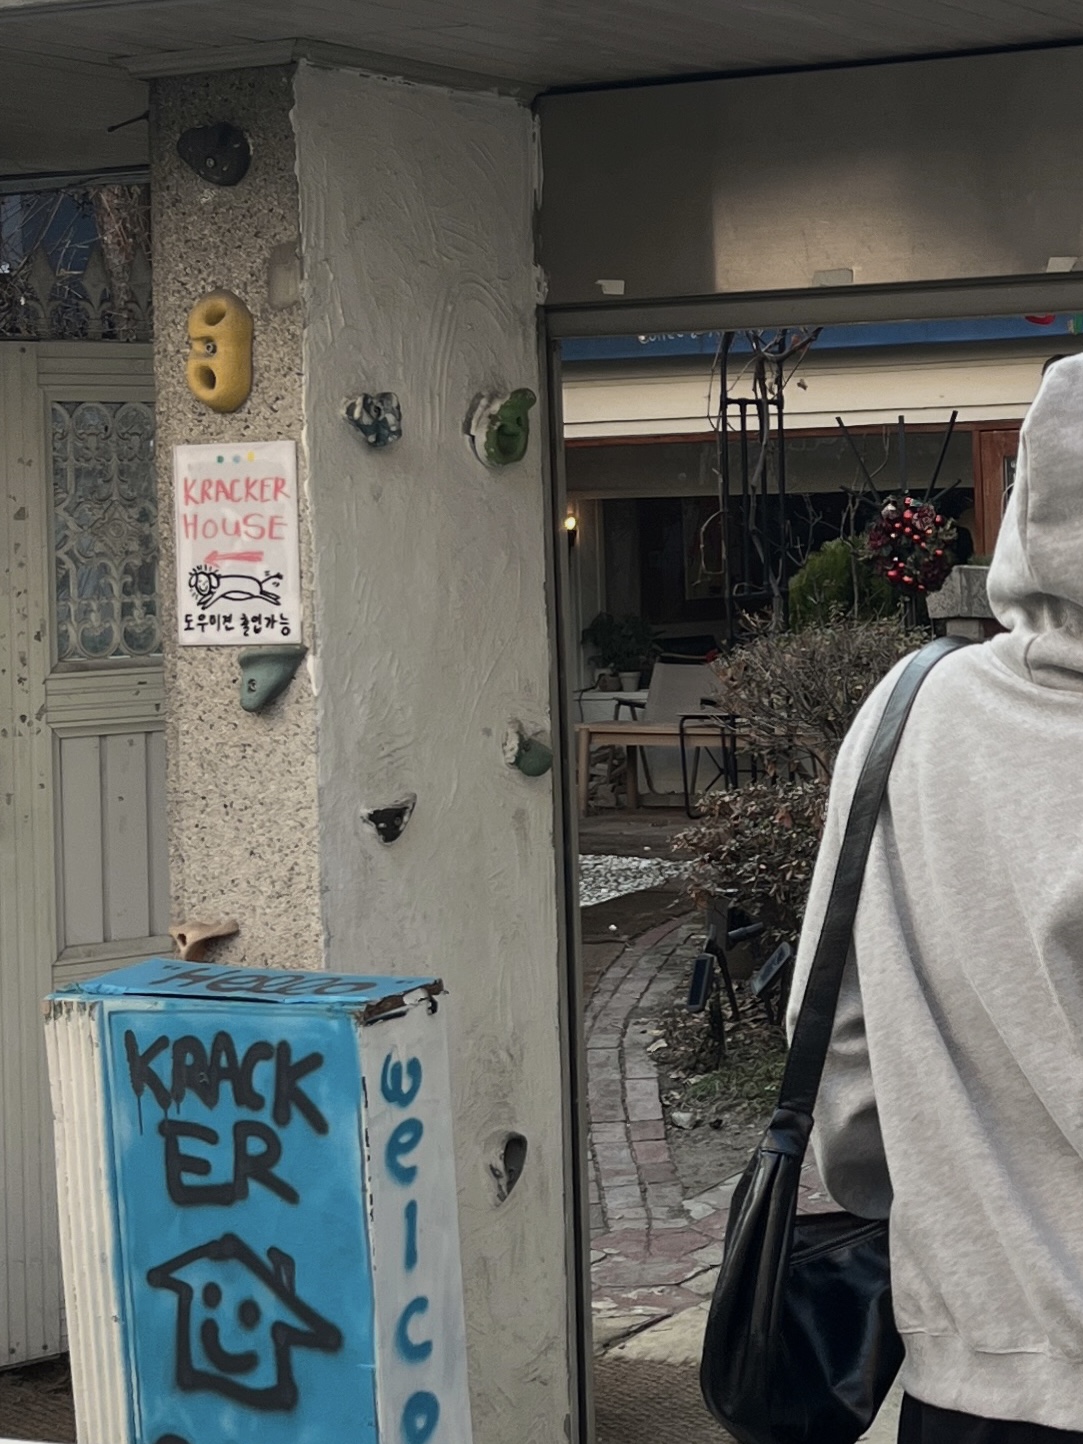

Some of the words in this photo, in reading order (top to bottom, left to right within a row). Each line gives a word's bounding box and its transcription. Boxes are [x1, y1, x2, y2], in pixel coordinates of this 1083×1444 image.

[183, 476, 290, 506] KRACKER
[183, 513, 288, 540] HOUSE
[184, 614, 235, 633] 도우미견
[158, 1118, 299, 1206] ER
